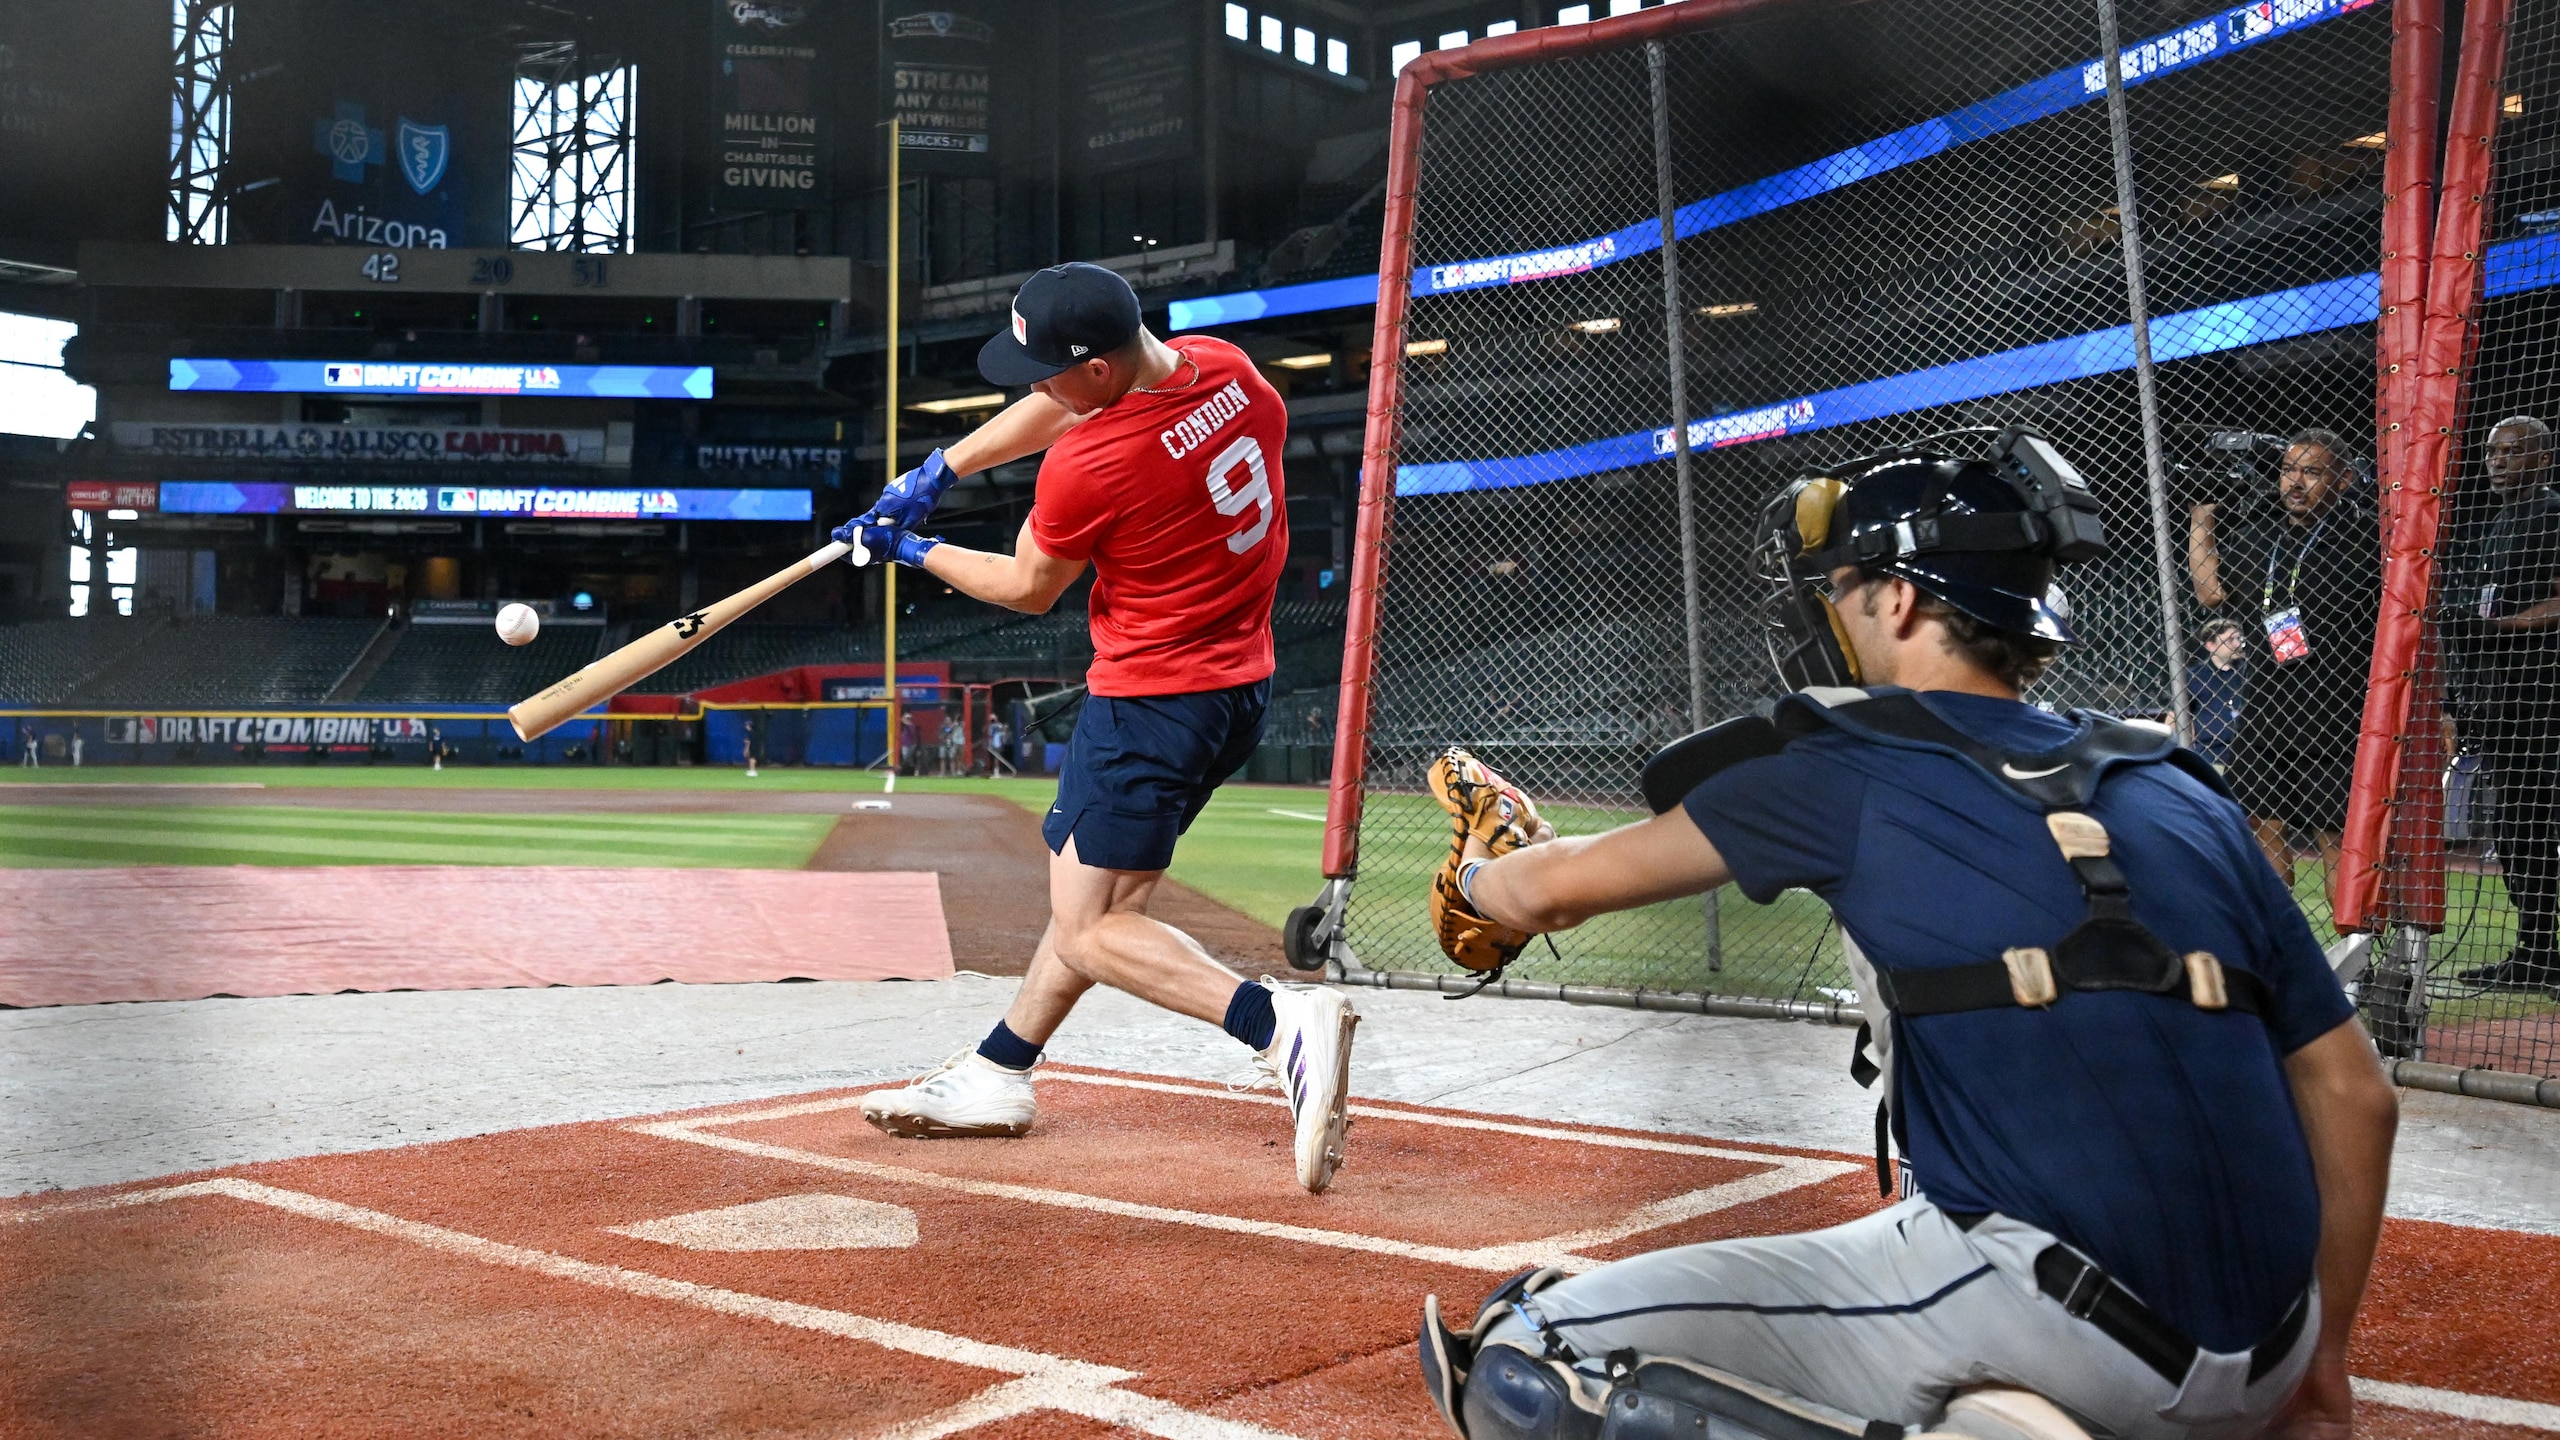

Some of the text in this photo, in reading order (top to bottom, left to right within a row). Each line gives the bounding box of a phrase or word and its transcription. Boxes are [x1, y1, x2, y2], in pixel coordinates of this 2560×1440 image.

[894, 70, 989, 93] STREAM
[894, 93, 988, 112] ANY GAME
[724, 113, 816, 134] MILLION
[894, 113, 988, 129] ANYWHERE
[760, 137, 779, 149] IN
[724, 152, 815, 166] CHARITABLE
[723, 167, 815, 189] GIVING
[312, 199, 447, 249] Arizona
[361, 253, 399, 283] 42
[471, 258, 513, 284] 20
[572, 259, 608, 288] 51
[364, 366, 420, 387] DRAFT
[419, 367, 525, 389] COMBINE
[1160, 377, 1251, 460] CONDON
[151, 428, 565, 455] ESTRELLA JALISCO CANTINA
[697, 446, 842, 470] CUTWATER
[294, 486, 354, 509] WELCOME
[354, 488, 371, 510] TO
[371, 488, 395, 510] THE
[394, 488, 429, 511] 2026
[479, 489, 535, 511] DRAFT
[533, 490, 641, 513] COMBINE
[1206, 435, 1273, 556] 9
